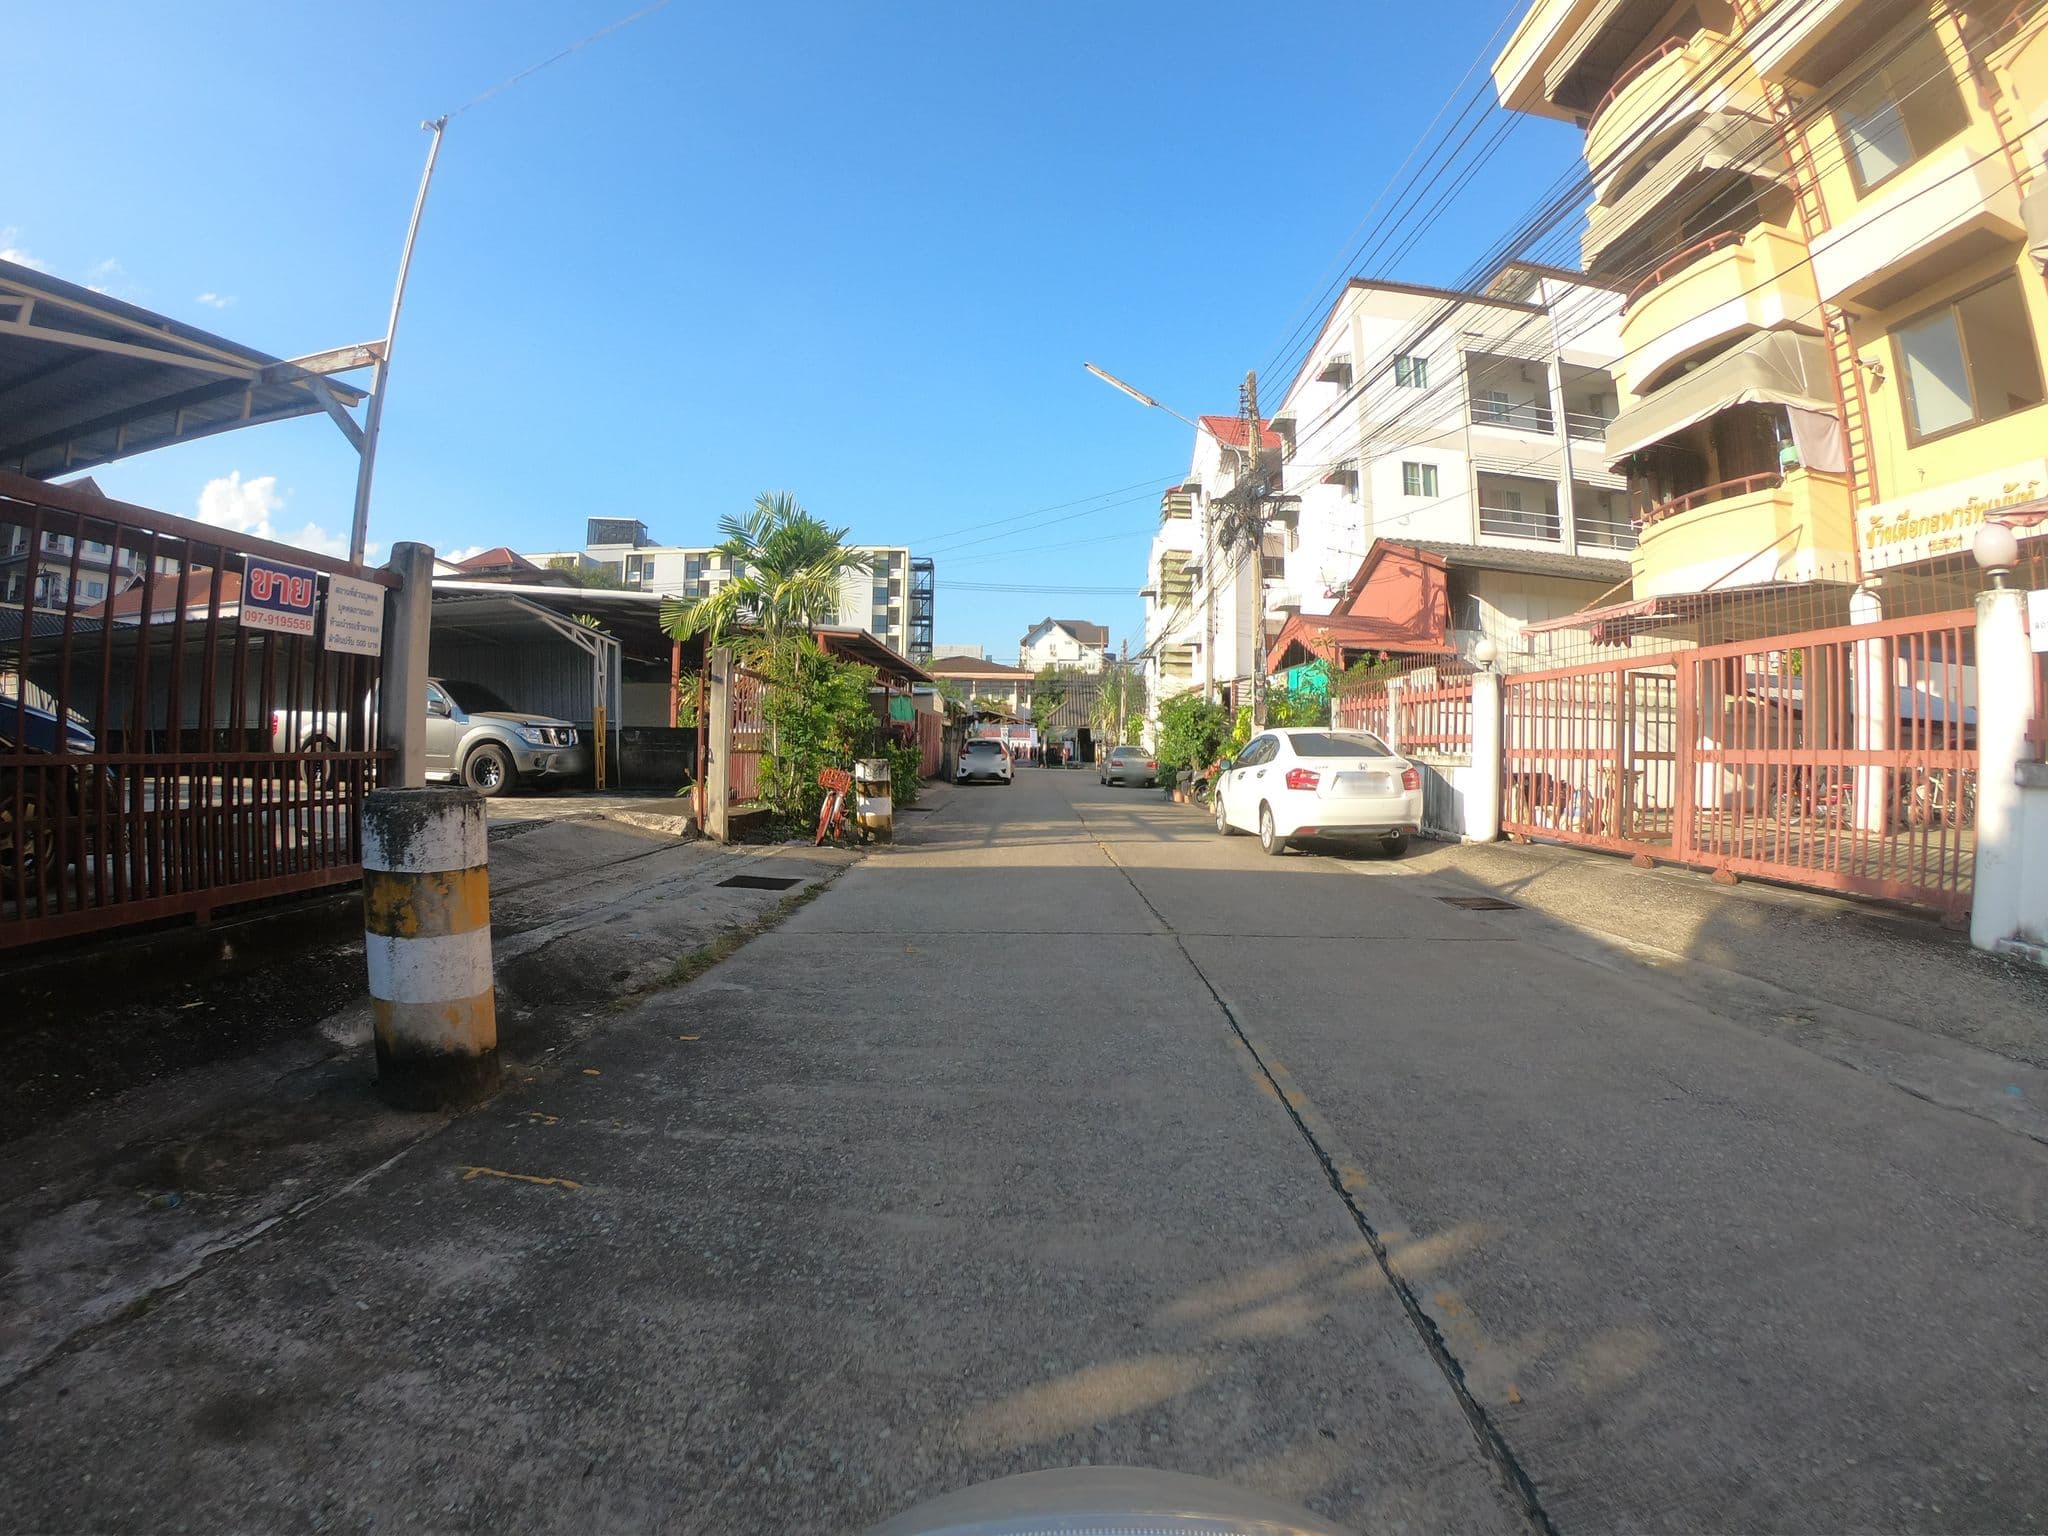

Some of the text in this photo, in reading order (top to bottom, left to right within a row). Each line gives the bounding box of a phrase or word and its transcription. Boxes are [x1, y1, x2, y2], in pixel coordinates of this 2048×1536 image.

[250, 567, 312, 608] ขาย
[244, 609, 312, 631] 097-9195556
[355, 639, 367, 648] 500
